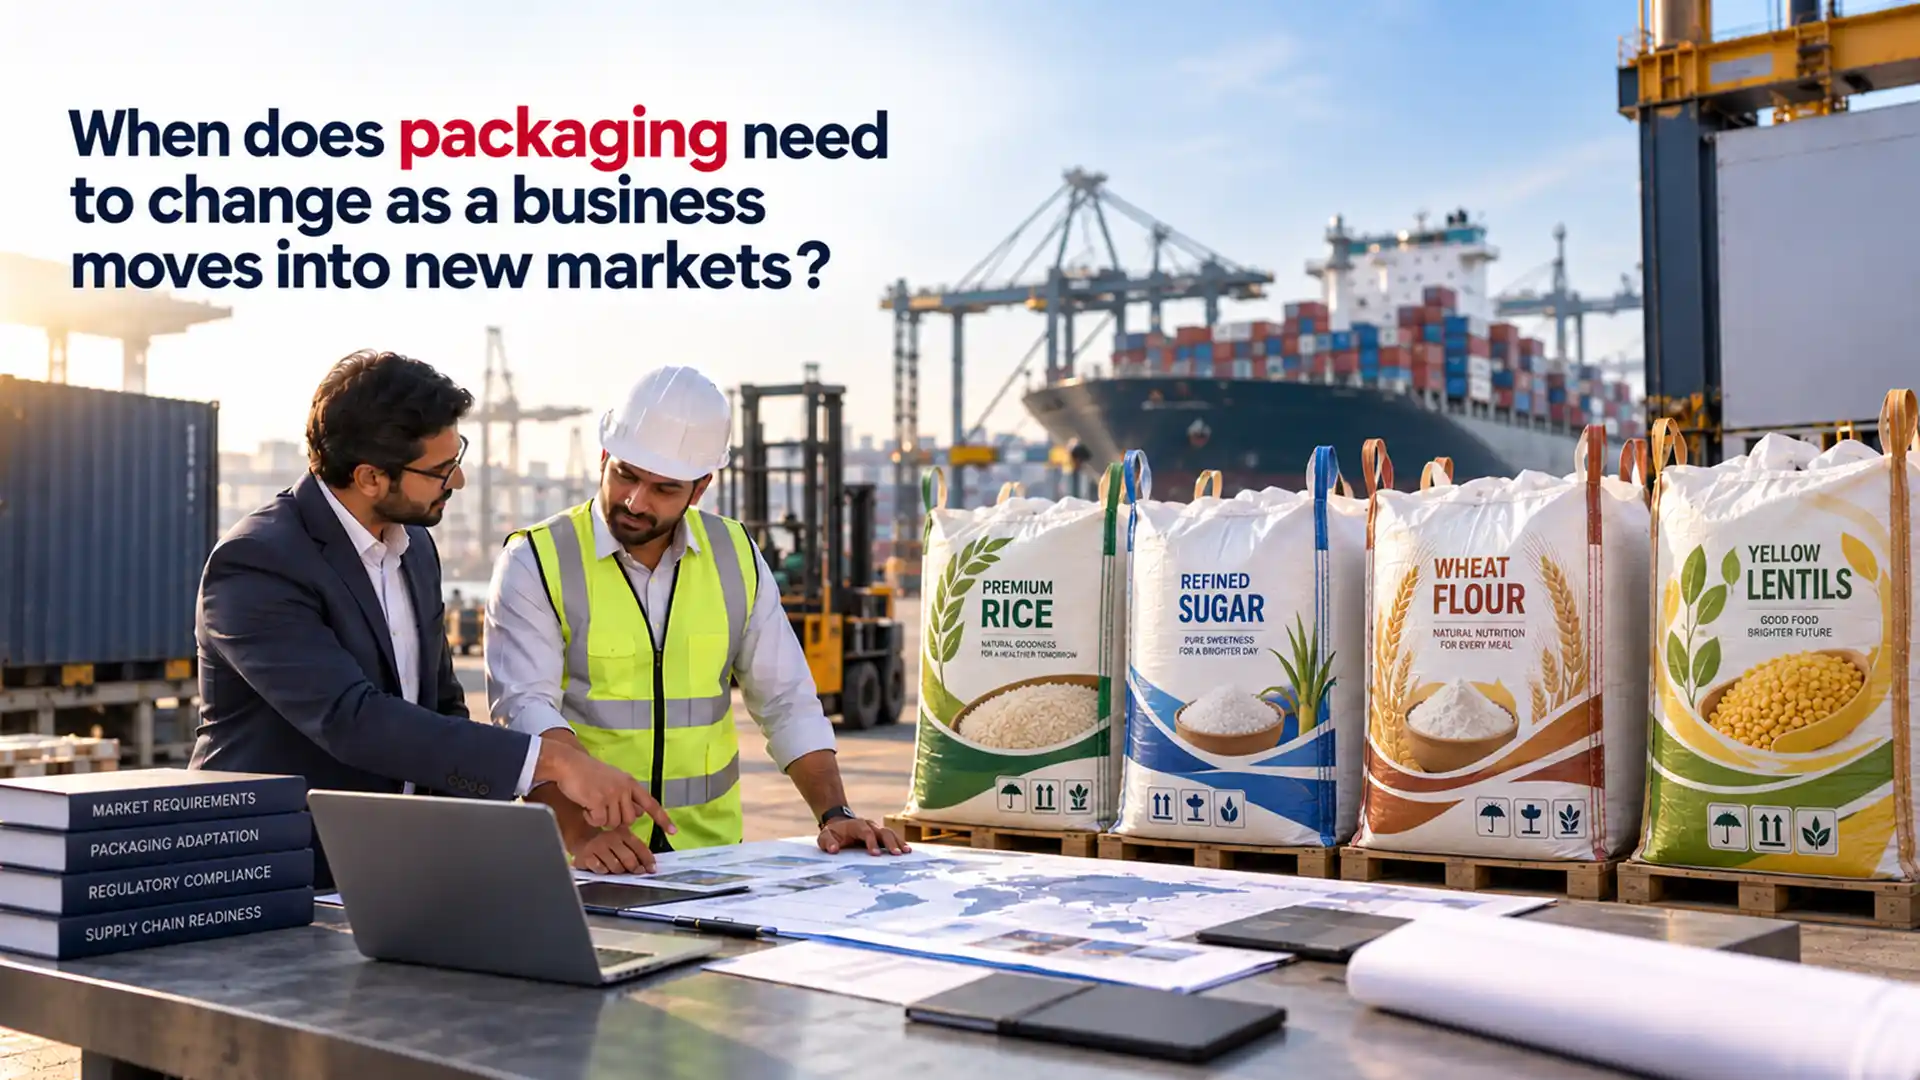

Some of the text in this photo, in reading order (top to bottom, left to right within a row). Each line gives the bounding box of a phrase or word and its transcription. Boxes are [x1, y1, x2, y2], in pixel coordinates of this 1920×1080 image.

[1748, 544, 1820, 564] YELLOW
[1434, 557, 1510, 579] WHEAT
[982, 580, 1053, 595] PREMIUM
[1181, 573, 1251, 590] REFINED
[1747, 568, 1853, 601] LENTILS
[1178, 594, 1265, 623] SUGAR
[1433, 583, 1526, 615] FLOUR
[981, 599, 1053, 629] RICE
[1760, 615, 1819, 625] GOOD FOOD
[1184, 635, 1255, 645] PURE SWEETNESS
[1433, 628, 1525, 638] NATURAL NUTRITION
[1747, 627, 1833, 638] BRIGHTER FUTURE
[981, 640, 1057, 649] NATURAL GOODNESS
[1179, 646, 1194, 656] FOR
[1195, 647, 1202, 656] A
[1243, 647, 1259, 656] DAY
[1440, 640, 1514, 650] FOR EVERY MEAL
[92, 792, 256, 818] MARKET REQUIREMENTS
[91, 829, 259, 857] PACKAGING ADAPTATION
[89, 865, 271, 900] REGULATORY COMPLIANCE
[86, 906, 262, 942] SUPPLY CHAIN READINESS
